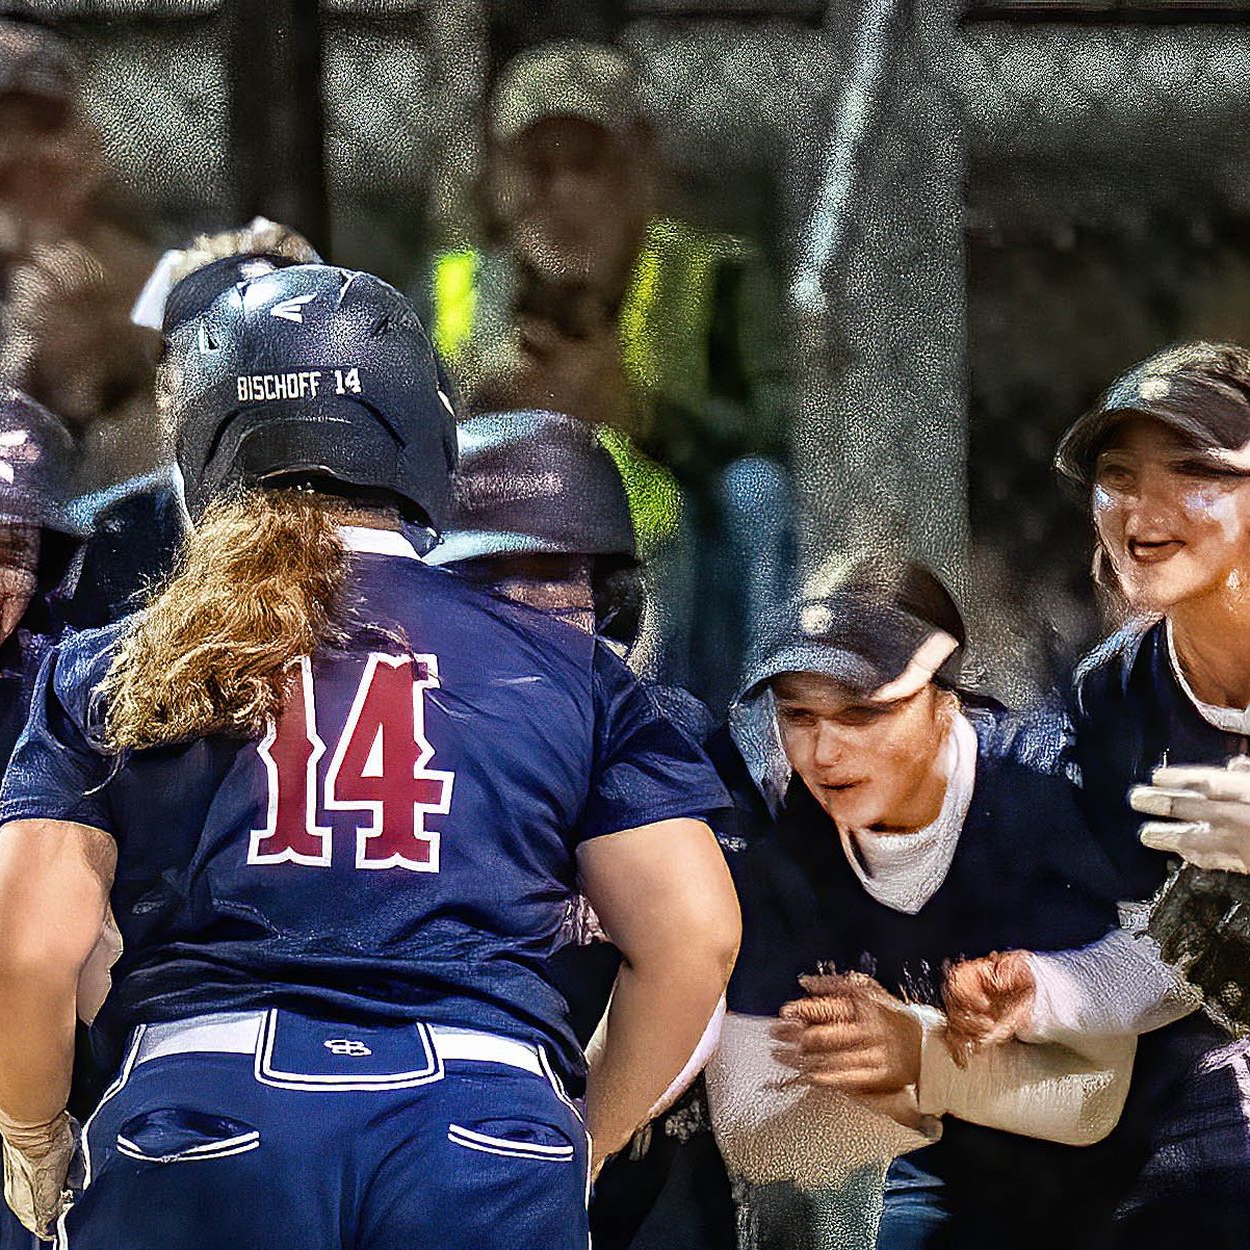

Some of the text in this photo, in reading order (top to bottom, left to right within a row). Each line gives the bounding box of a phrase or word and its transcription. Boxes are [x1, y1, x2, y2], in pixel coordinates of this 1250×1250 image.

[237, 367, 362, 401] BISCHOFF 14
[247, 652, 455, 873] 14
